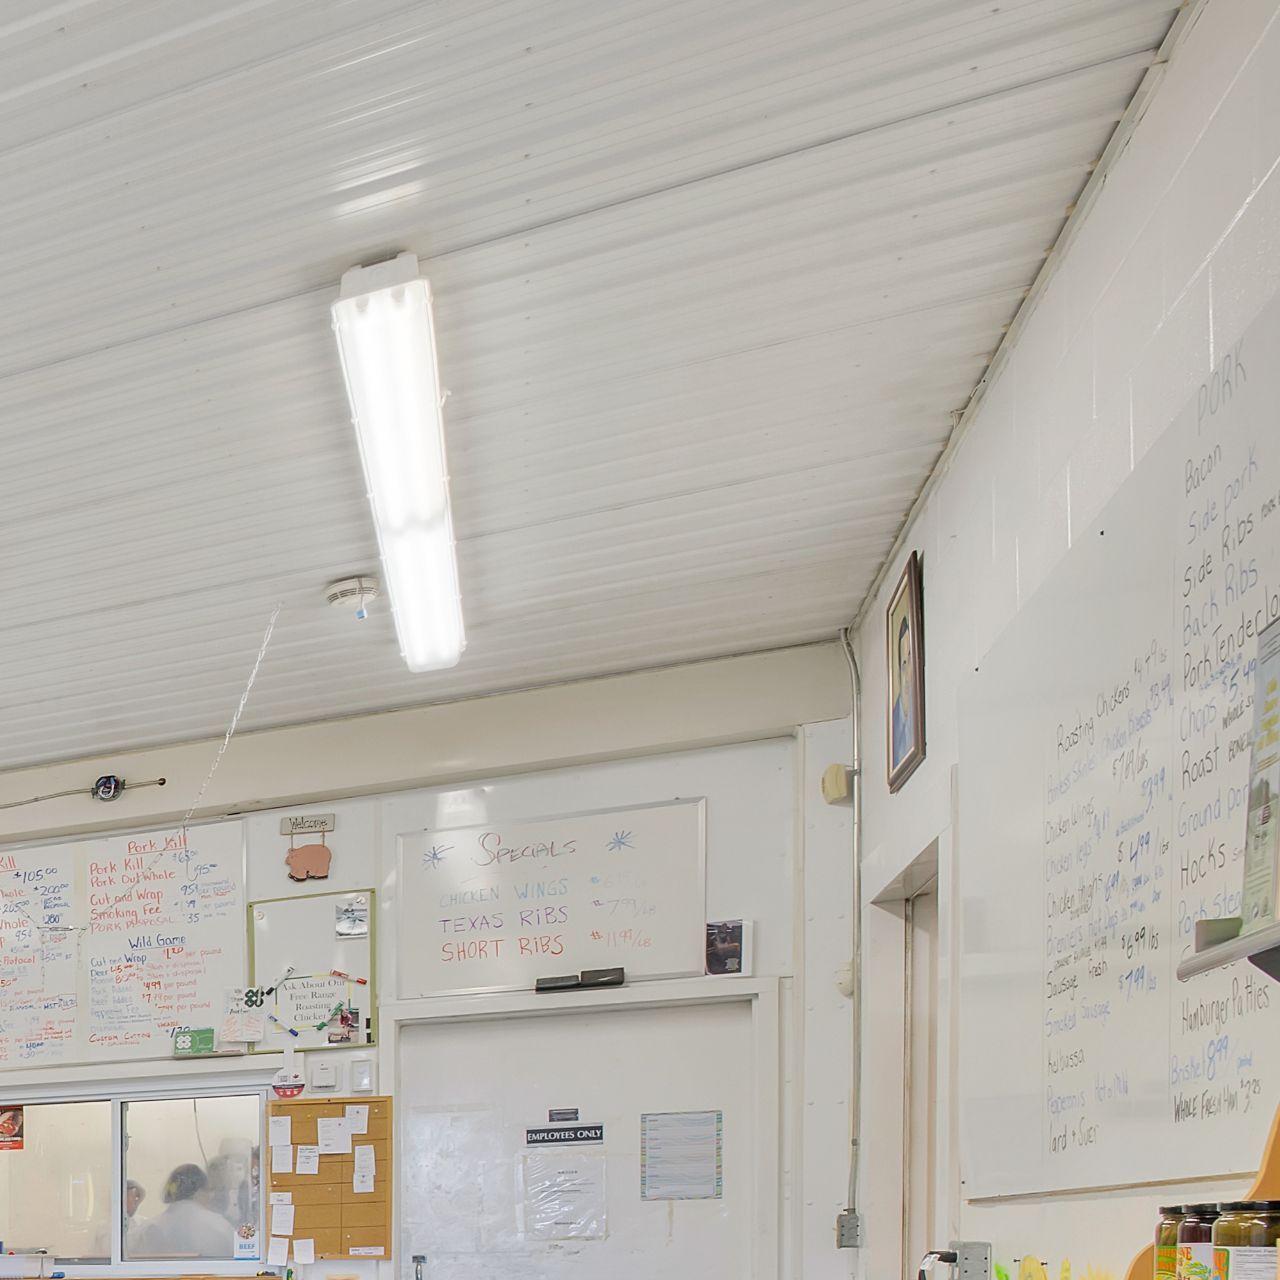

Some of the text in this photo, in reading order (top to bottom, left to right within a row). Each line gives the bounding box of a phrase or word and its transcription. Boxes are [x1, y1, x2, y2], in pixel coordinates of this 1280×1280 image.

[1186, 444, 1221, 496] Bacon
[1188, 499, 1217, 544] Side
[1183, 512, 1253, 597] Side Ribs
[1226, 559, 1258, 605] Ribs
[1184, 646, 1211, 691] Pork
[1180, 701, 1216, 741] Chops
[1057, 708, 1095, 761] Roasting
[1183, 731, 1219, 790] Roast
[1179, 790, 1221, 837] Ground
[290, 817, 327, 830] Welcome
[128, 835, 186, 853] Pork Kill
[90, 857, 143, 875] Pork Kill
[1181, 837, 1225, 890] Hocks
[91, 871, 176, 887] Pork Out Whole
[90, 890, 163, 906] Cut and Wrap
[441, 887, 500, 908] CHICKEN
[515, 879, 568, 900] WINGS
[91, 902, 161, 921] Smoking Fee
[90, 922, 121, 934] PORK
[439, 913, 503, 933] TEXAS
[128, 934, 186, 949] Wild Game
[441, 940, 503, 962] SHORT
[4, 955, 35, 965] Protocol
[124, 954, 146, 963] Wrap
[299, 980, 325, 989] About
[290, 991, 336, 1001] Free Range
[296, 1002, 330, 1012] Roasting
[1182, 999, 1230, 1035] Hamburger
[527, 1129, 602, 1141] EMPLOYEES ONLY
